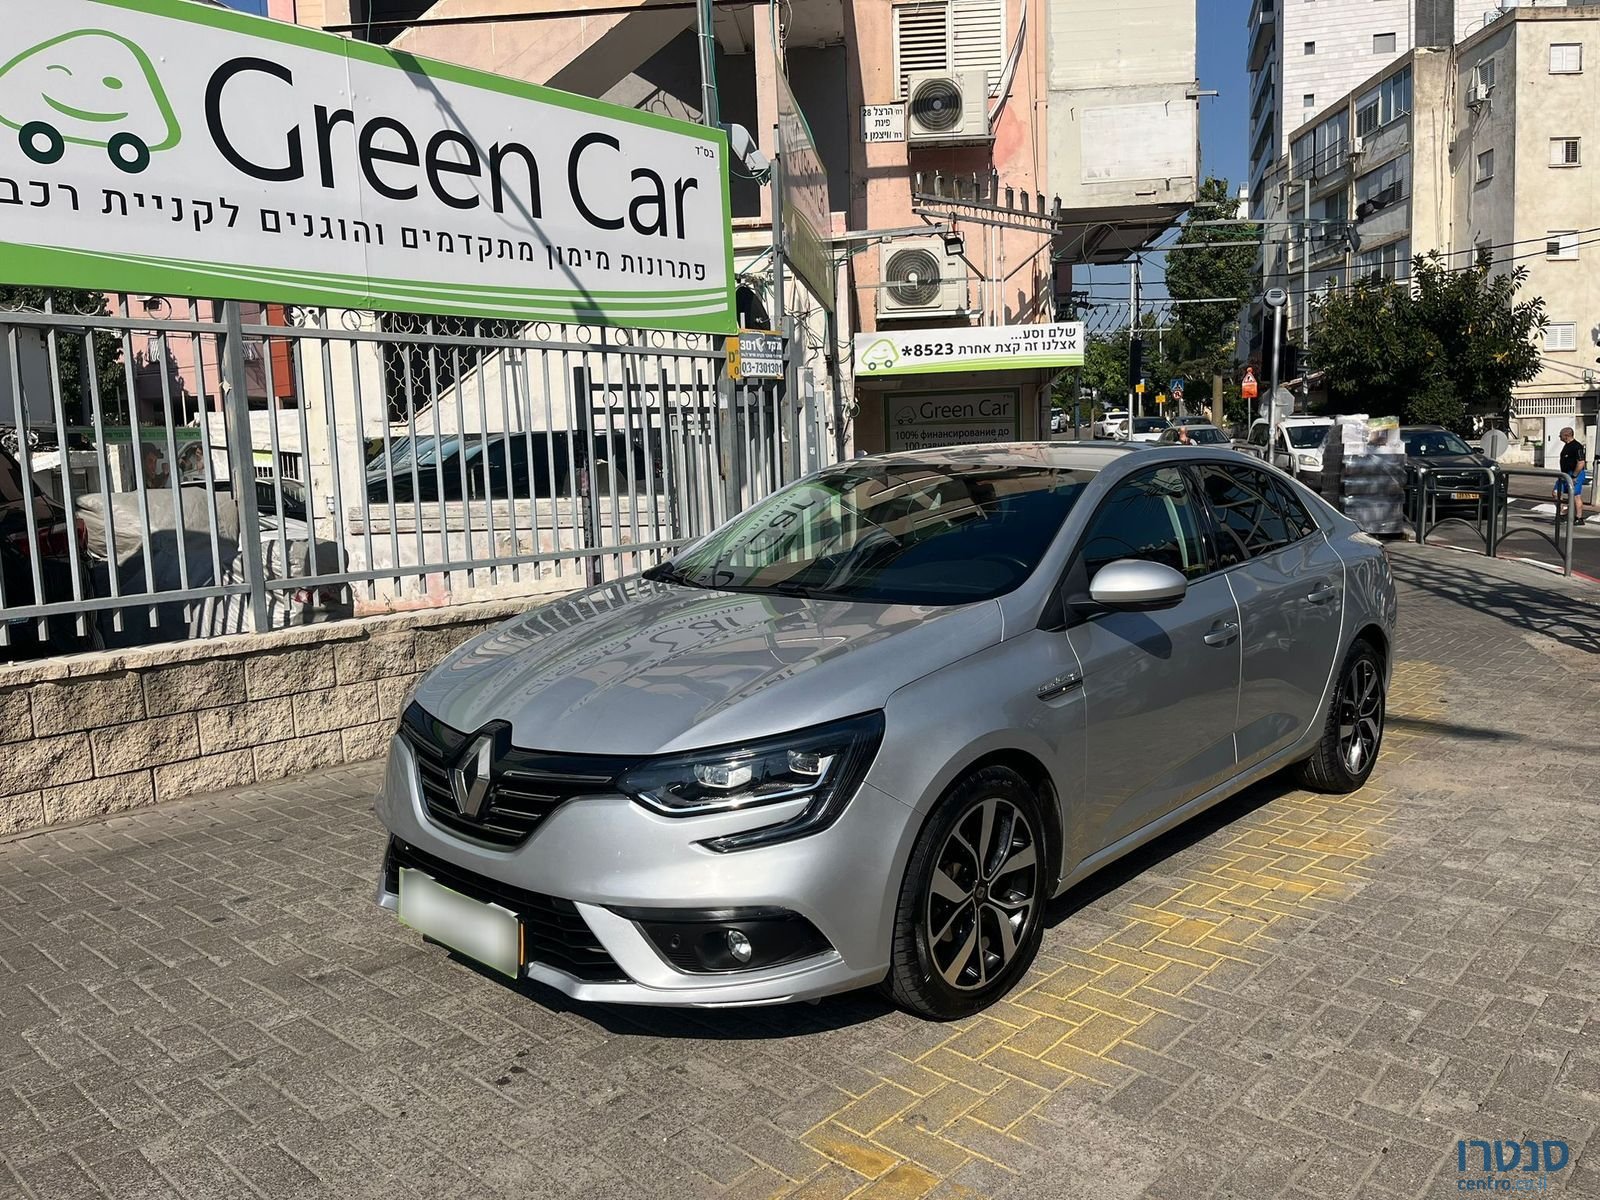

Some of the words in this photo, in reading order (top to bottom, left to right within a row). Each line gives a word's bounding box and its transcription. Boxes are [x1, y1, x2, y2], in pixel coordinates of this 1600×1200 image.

[863, 109, 872, 117] 28
[873, 106, 893, 116] הרצל
[874, 119, 891, 127] פינת
[204, 56, 543, 219] Green
[567, 132, 699, 240] Car
[695, 146, 714, 158] בס"ד
[0, 177, 79, 210] רכב
[102, 188, 239, 232] לקניית
[260, 208, 384, 246] והוגנים
[401, 227, 534, 263] מתקדמים
[546, 245, 610, 270] מימון
[620, 254, 706, 280] פתרונות
[1048, 327, 1076, 338] שלם
[740, 340, 756, 351] 301
[958, 344, 991, 355] אחרת
[994, 342, 1020, 355] קצת
[1024, 341, 1038, 351] זה
[1042, 339, 1076, 350] אצלנו
[741, 361, 783, 374] 03-7301301
[919, 401, 974, 419] Green
[979, 399, 1009, 416] Car
[895, 430, 919, 440] 100%
[920, 429, 996, 440] финансирование
[997, 428, 1009, 437] до
[904, 442, 919, 451] 100
